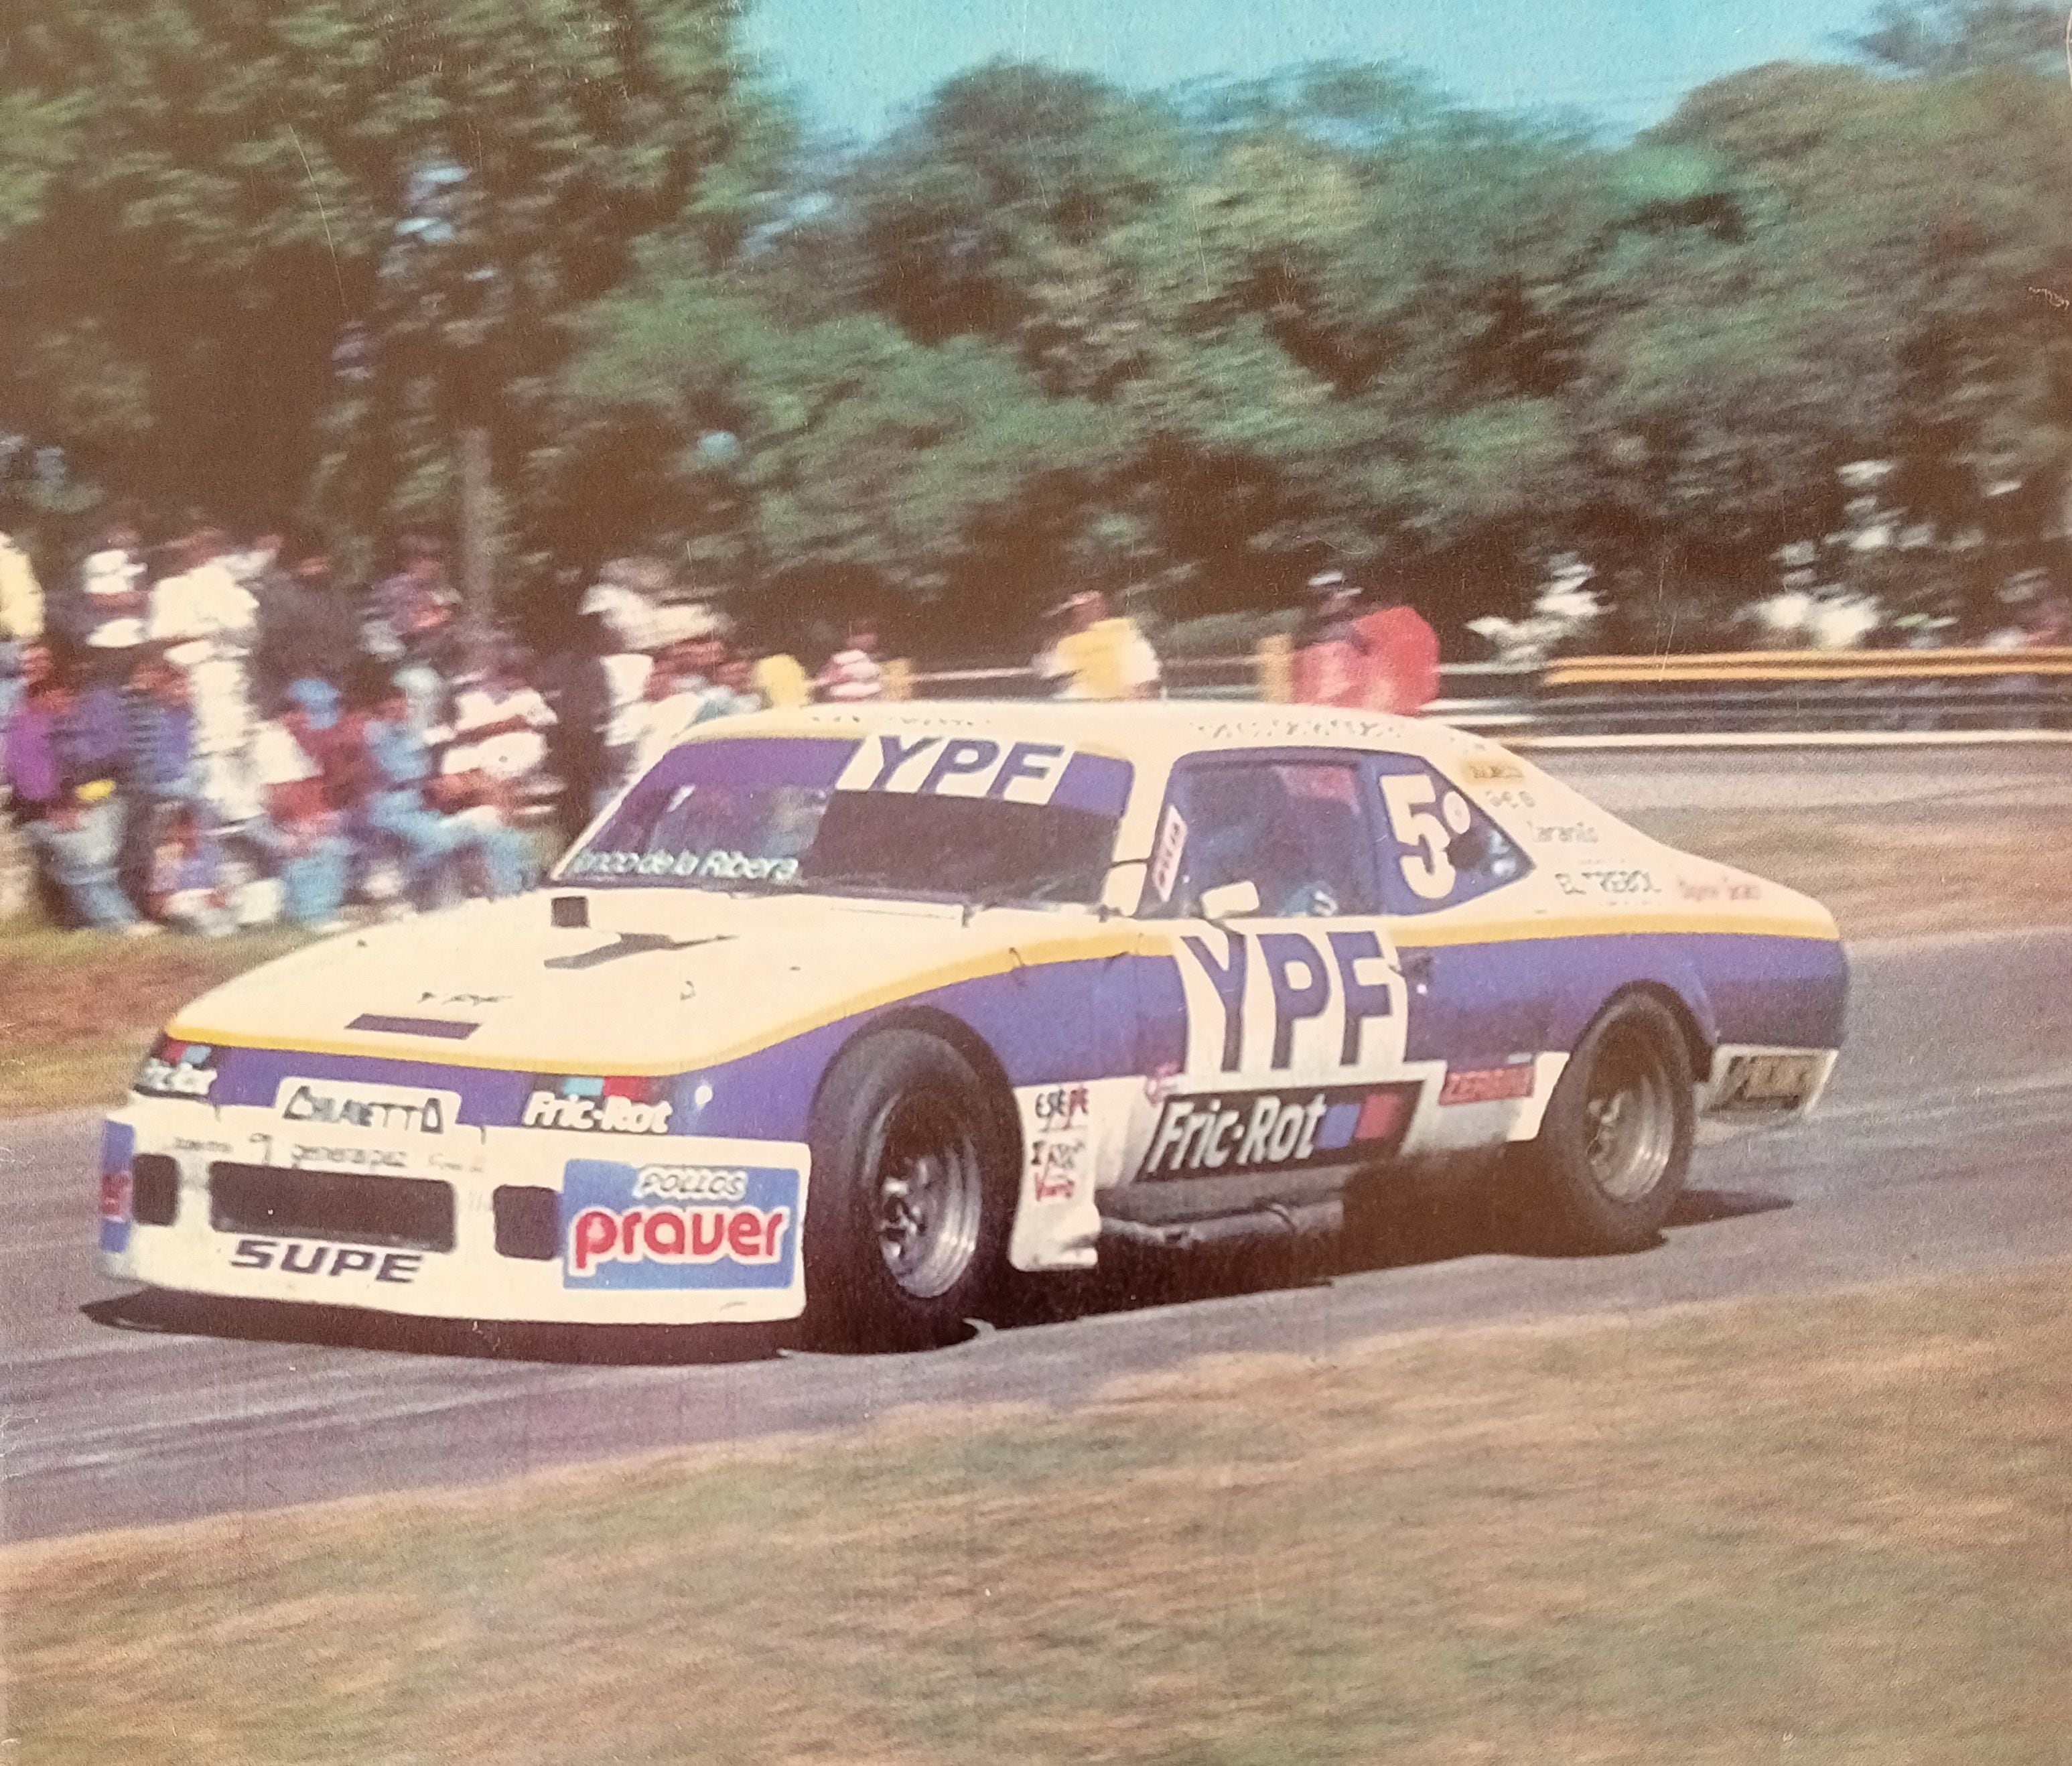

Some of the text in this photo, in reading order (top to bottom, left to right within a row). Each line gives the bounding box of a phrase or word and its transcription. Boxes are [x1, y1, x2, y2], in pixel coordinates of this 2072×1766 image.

[872, 734, 1063, 800] YPF
[699, 849, 799, 881] Ribera
[1180, 931, 1393, 1072] YPF
[640, 1172, 742, 1197] POLLOS
[231, 1239, 423, 1283] SUPE
